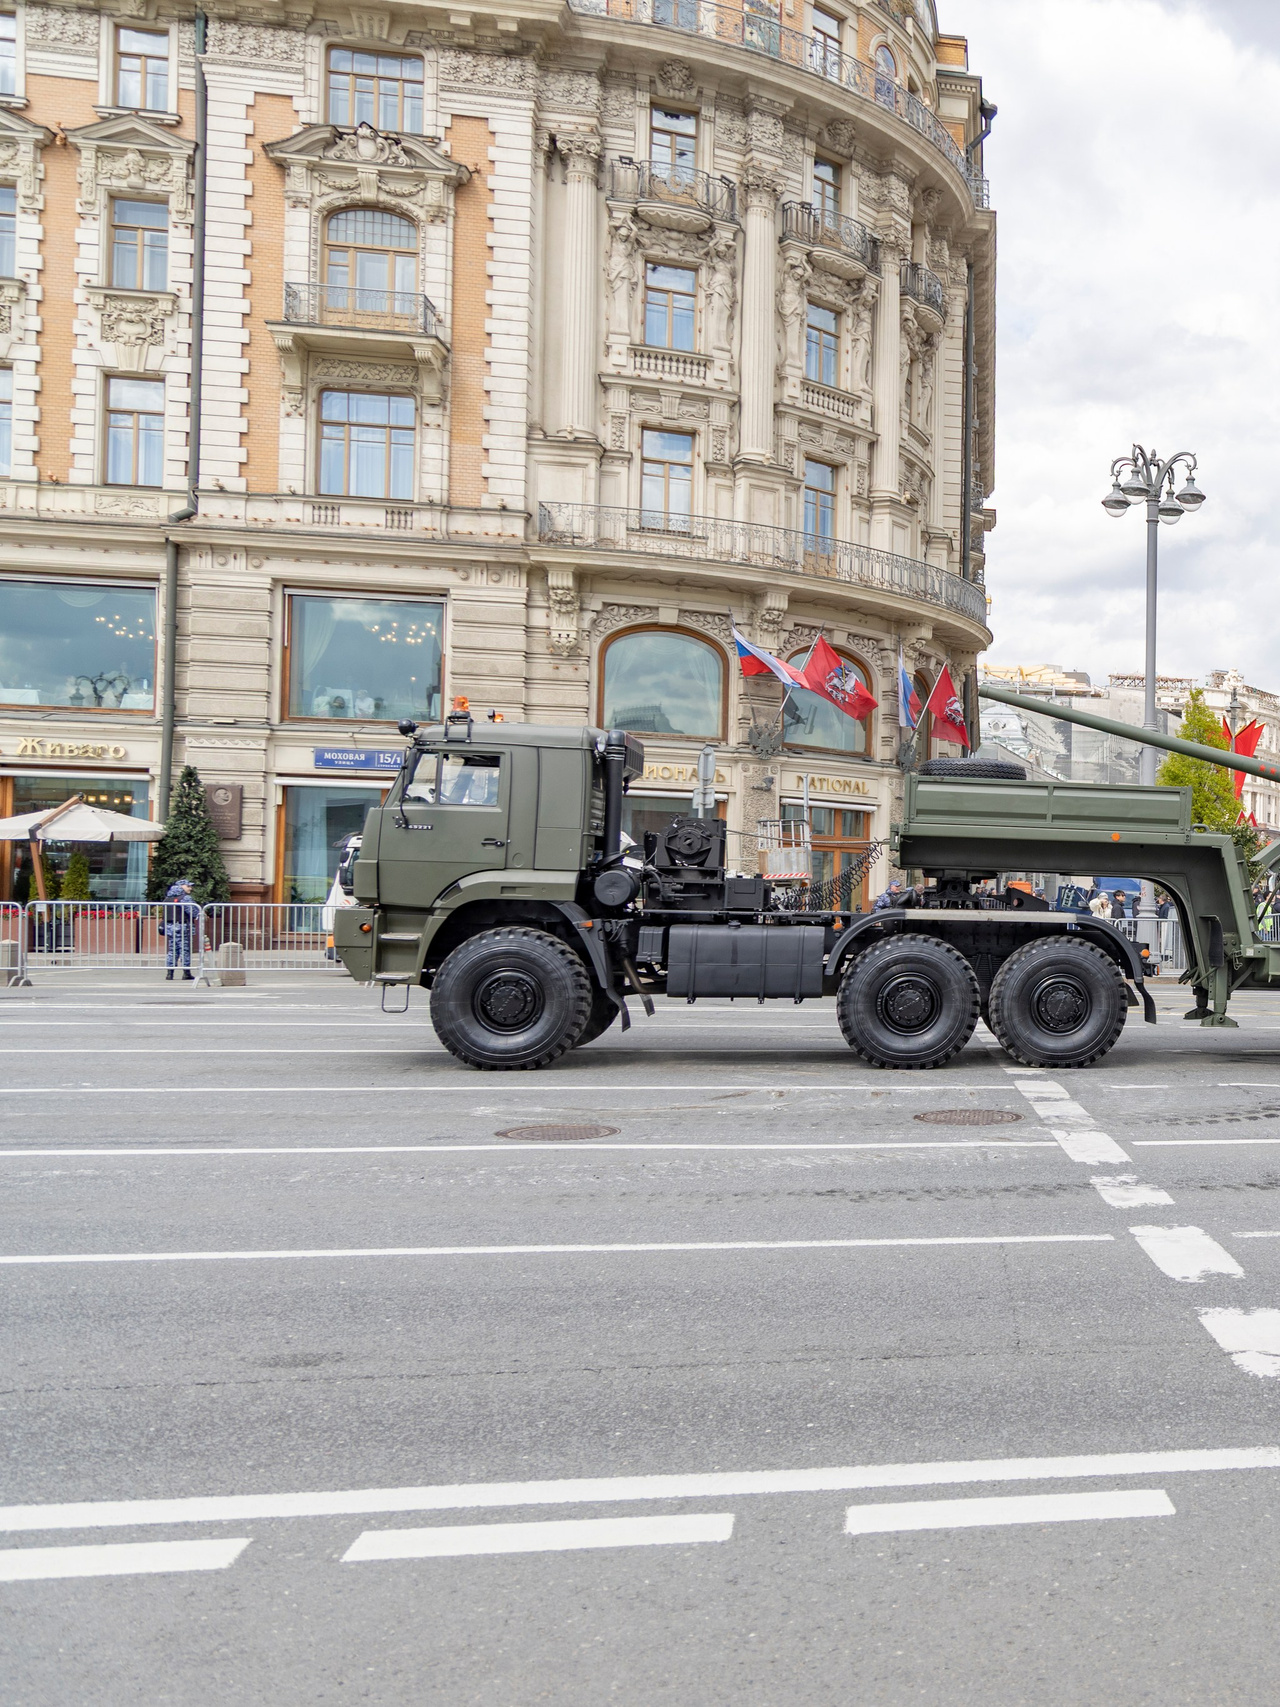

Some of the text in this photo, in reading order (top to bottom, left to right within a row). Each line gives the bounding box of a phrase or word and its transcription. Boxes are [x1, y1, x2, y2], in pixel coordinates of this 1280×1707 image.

[16, 737, 127, 759] Живаго
[324, 752, 366, 761] МОХОВАЯ
[378, 753, 401, 765] 15/1
[640, 763, 726, 783] ИОНАЬ
[796, 775, 869, 795] NATIONAL
